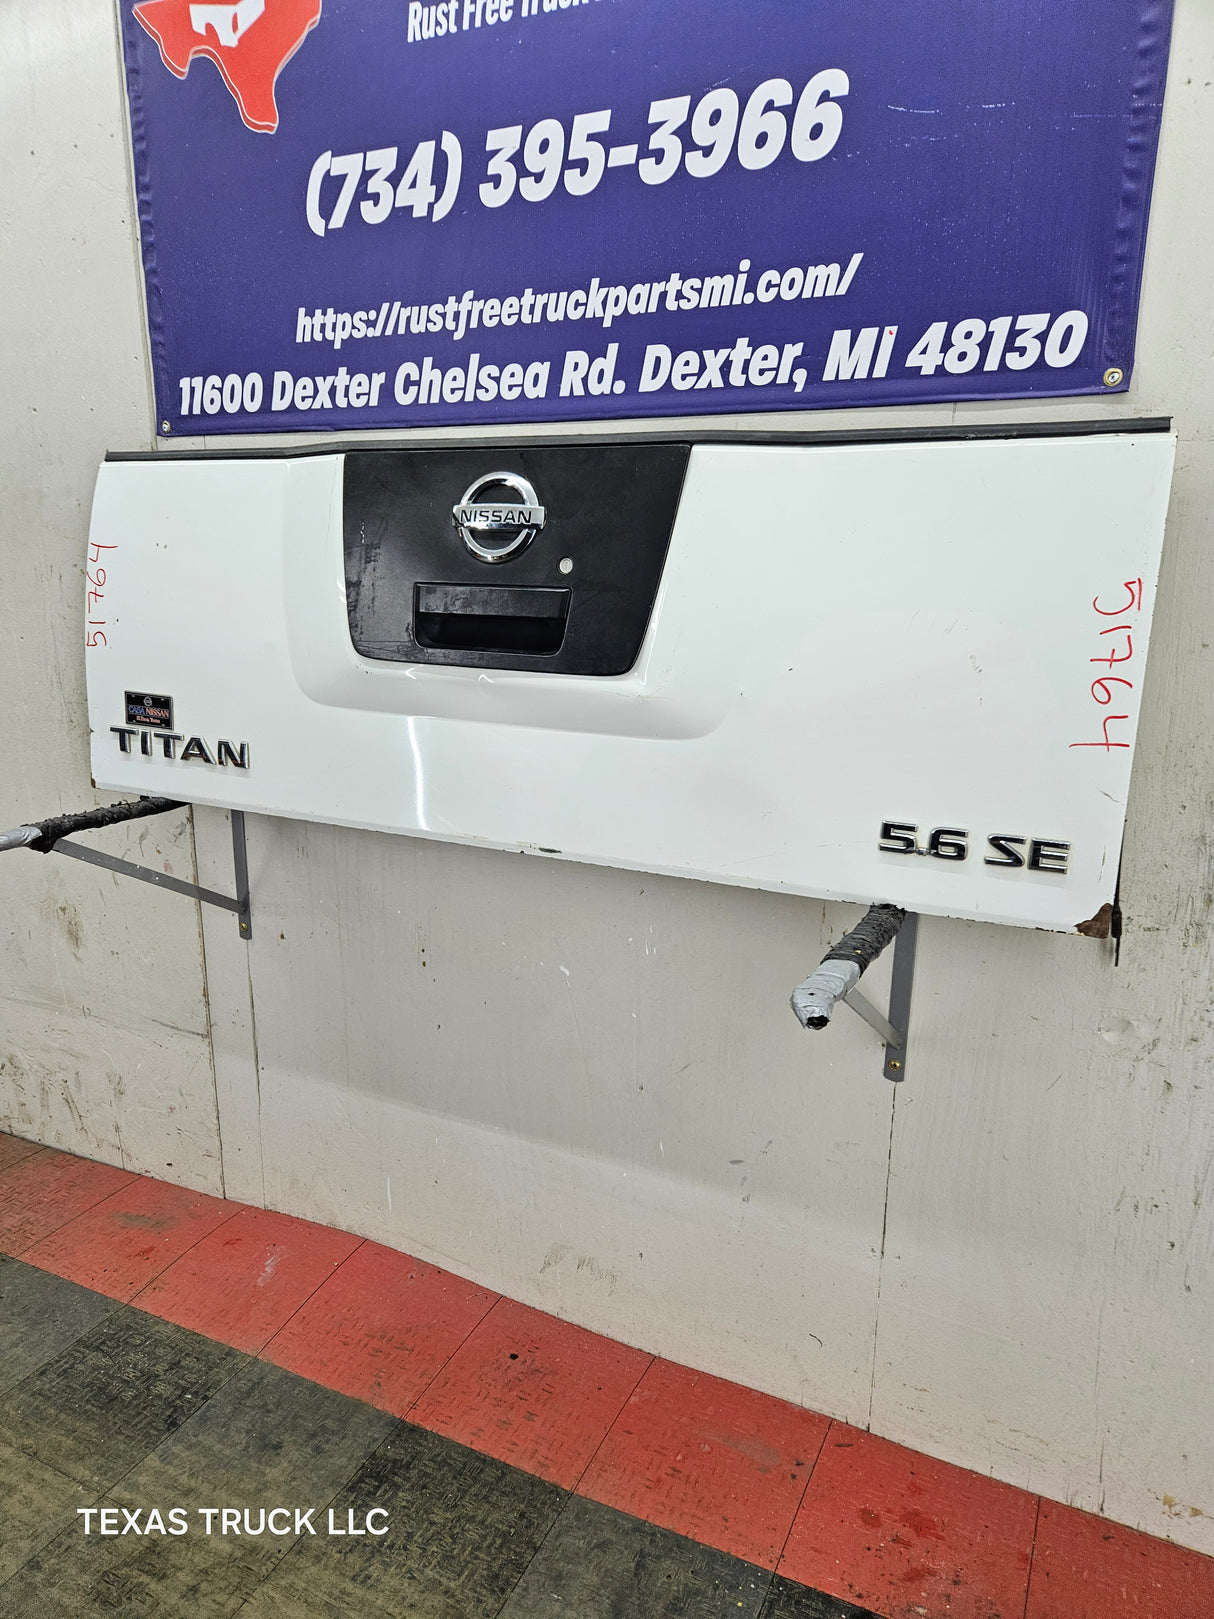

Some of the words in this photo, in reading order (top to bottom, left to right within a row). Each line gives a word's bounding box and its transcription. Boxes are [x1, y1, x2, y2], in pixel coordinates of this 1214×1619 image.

[407, 1, 458, 43] Rust
[462, 0, 515, 31] Free
[306, 130, 463, 237] (734)
[478, 68, 850, 209] 395-3966
[295, 252, 864, 350] https://rustfreetruckpartsmi.com/
[179, 370, 263, 416] 11600
[271, 364, 386, 412] Dexter
[393, 353, 550, 406] Chelsea
[559, 343, 626, 398] Rd.
[638, 336, 808, 394] Dexter,
[821, 325, 899, 382] MI
[905, 309, 1089, 377] 48130
[460, 508, 532, 524] NISSAN
[1068, 577, 1144, 752] 51764
[110, 725, 250, 770] TITAN
[879, 820, 969, 861] 5.6
[984, 833, 1071, 875] SE
